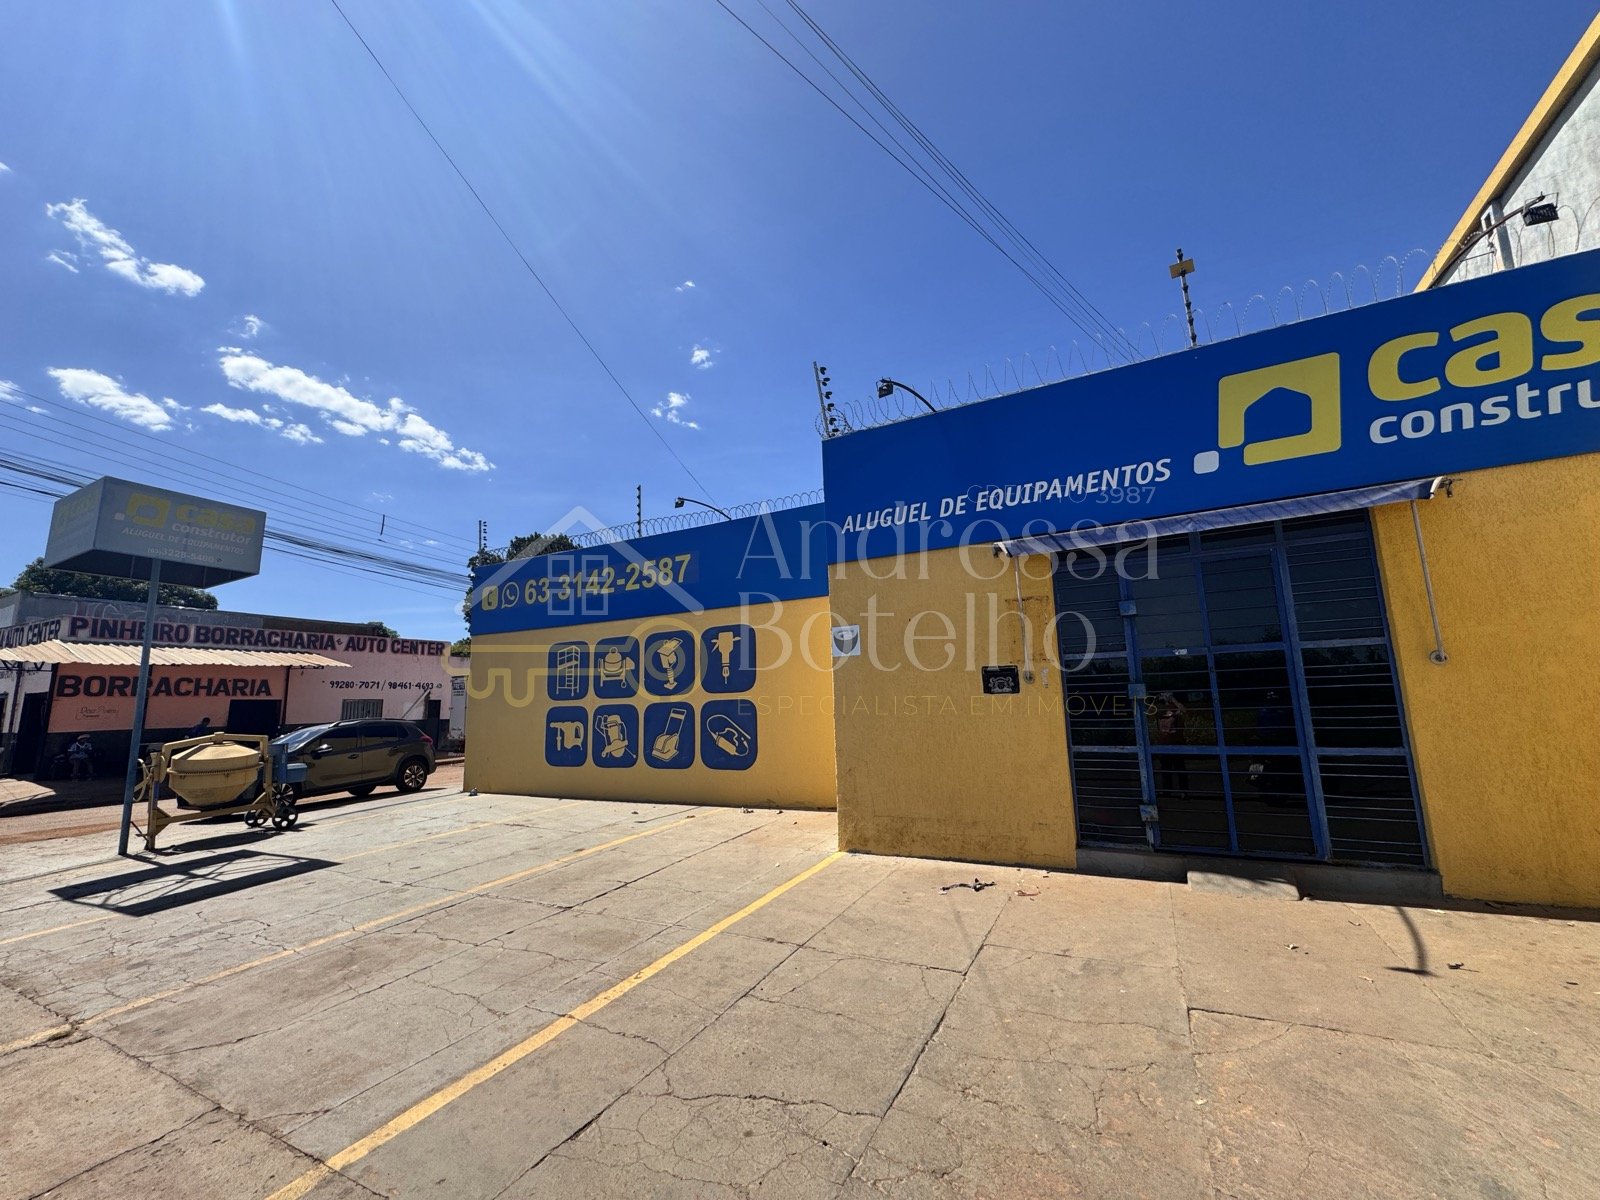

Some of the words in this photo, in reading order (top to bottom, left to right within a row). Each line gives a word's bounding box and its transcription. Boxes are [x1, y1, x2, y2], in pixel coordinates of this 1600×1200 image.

[841, 502, 932, 534] ALUGUEL
[939, 494, 967, 516] DE
[975, 457, 1172, 512] EQUIPAMENTOS
[175, 503, 256, 534] casa
[121, 527, 166, 541] ALUGUEL
[168, 534, 180, 544] DE
[182, 537, 245, 555] EQUIPAMENTOS
[171, 523, 252, 545] construtor
[524, 578, 550, 605] 63
[561, 554, 692, 601] 3142-2587
[5, 627, 24, 648] AUTO
[26, 618, 61, 644] CENTER
[69, 616, 190, 644] PINHEIRO
[194, 625, 337, 650] BORRACHARIA
[345, 636, 387, 653] AUTO
[391, 639, 446, 656] CENTER
[55, 674, 272, 698] BORRACHARIA
